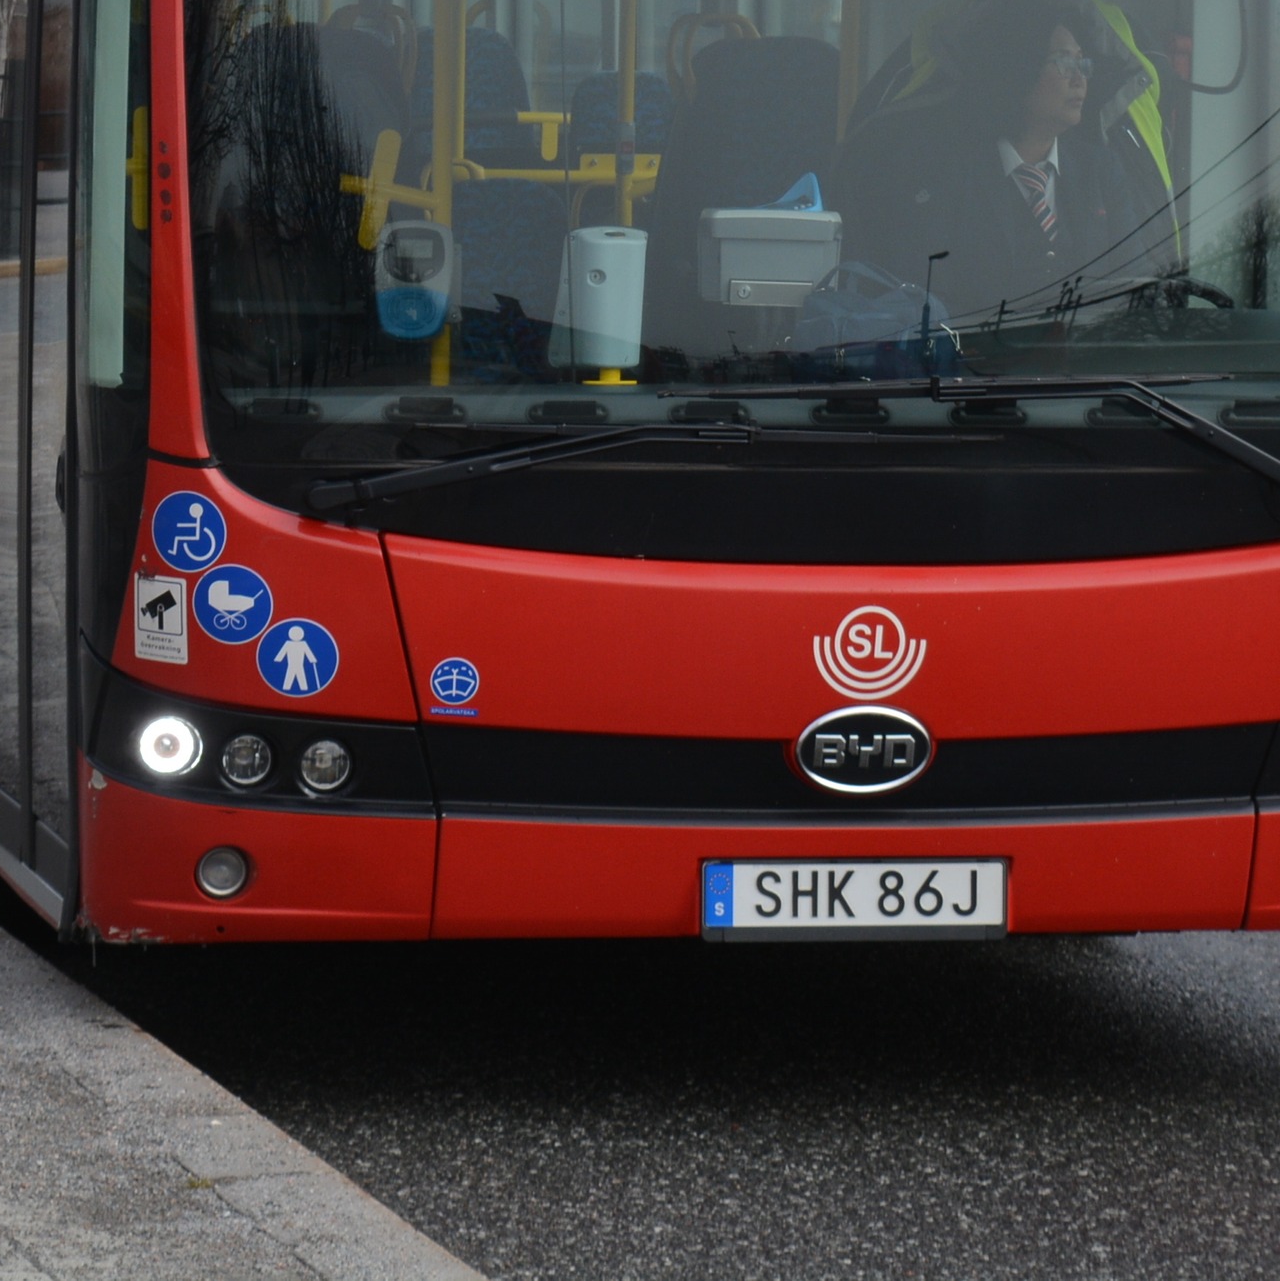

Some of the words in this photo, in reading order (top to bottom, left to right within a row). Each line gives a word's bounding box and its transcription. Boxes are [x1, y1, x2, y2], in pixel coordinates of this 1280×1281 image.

[846, 623, 893, 660] SL
[813, 733, 916, 768] BYD
[714, 902, 725, 917] S
[754, 870, 855, 918] SHK
[877, 869, 978, 917] 86J
